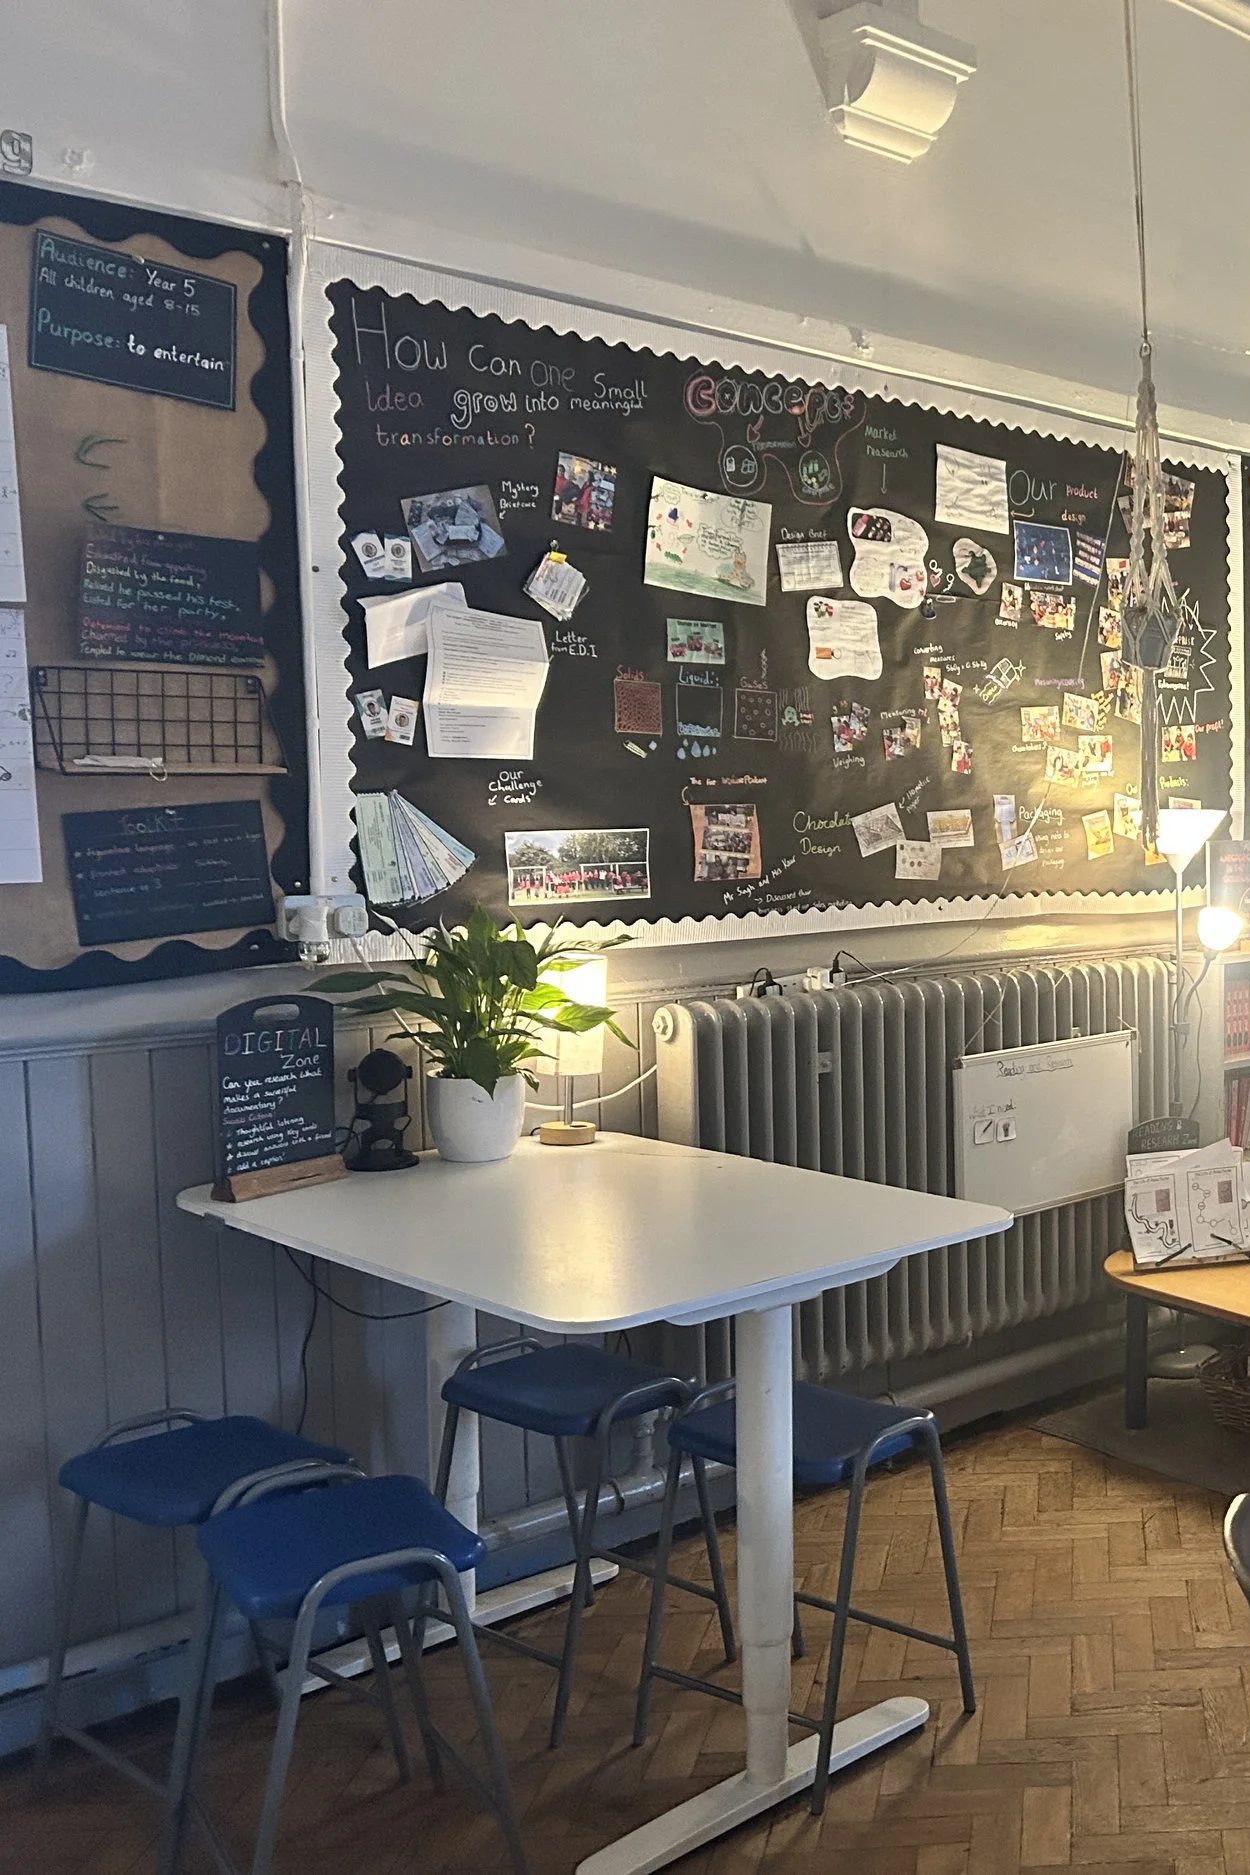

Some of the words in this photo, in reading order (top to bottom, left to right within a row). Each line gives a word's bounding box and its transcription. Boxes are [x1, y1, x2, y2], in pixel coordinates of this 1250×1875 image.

[40, 239, 134, 279] Audience:
[146, 268, 176, 291] Year
[184, 280, 196, 297] 5
[39, 267, 57, 286] All
[65, 274, 114, 299] children
[123, 292, 153, 311] aged
[164, 299, 200, 317] 8-15
[38, 308, 121, 348] Purpose:
[127, 334, 146, 356] to
[154, 346, 225, 371] entertain
[352, 297, 448, 371] How
[468, 344, 522, 377] Can
[594, 372, 648, 400] Small
[450, 389, 518, 430] grow
[524, 393, 560, 414] into
[864, 425, 898, 441] Market
[502, 481, 539, 498] Mystery
[1008, 470, 1058, 506] Our
[1065, 483, 1098, 500] product
[1061, 509, 1087, 524] design
[780, 527, 805, 542] Design
[555, 631, 588, 643] Letter
[616, 664, 645, 681] Solids
[740, 677, 769, 690] Gases
[880, 708, 916, 720] Measuring
[832, 754, 866, 769] Weighing
[495, 770, 524, 782] Our
[488, 779, 543, 796] Challenge
[801, 837, 841, 856] Design
[224, 1027, 327, 1056] DIGITAL
[280, 1053, 320, 1069] Zone
[223, 1076, 241, 1090] Can
[244, 1079, 263, 1093] you
[300, 1067, 323, 1079] what
[223, 1094, 250, 1104] makes
